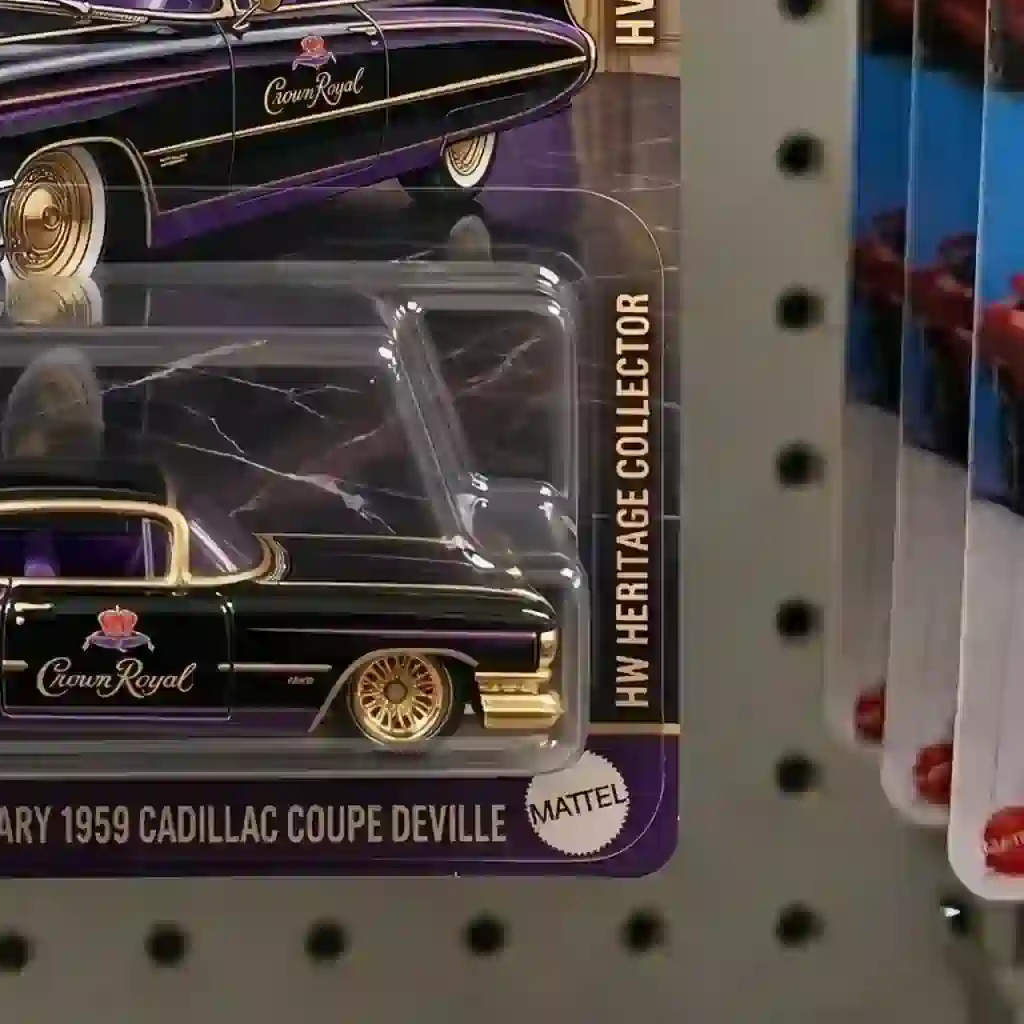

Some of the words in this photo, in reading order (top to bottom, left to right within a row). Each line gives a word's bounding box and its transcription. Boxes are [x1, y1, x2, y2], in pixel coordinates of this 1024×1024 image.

[264, 77, 314, 115] Crown
[307, 67, 365, 106] Royal
[616, 293, 650, 479] COLLECTOR
[616, 489, 650, 644] HERITAGE
[36, 657, 112, 697] Crown
[96, 658, 197, 698] Royal
[616, 656, 650, 707] HW
[61, 805, 129, 844] 1959
[139, 804, 278, 844] CADILLAC
[287, 804, 382, 843] COUPE
[392, 804, 507, 843] DEVILLE
[529, 783, 628, 825] MATTEL
